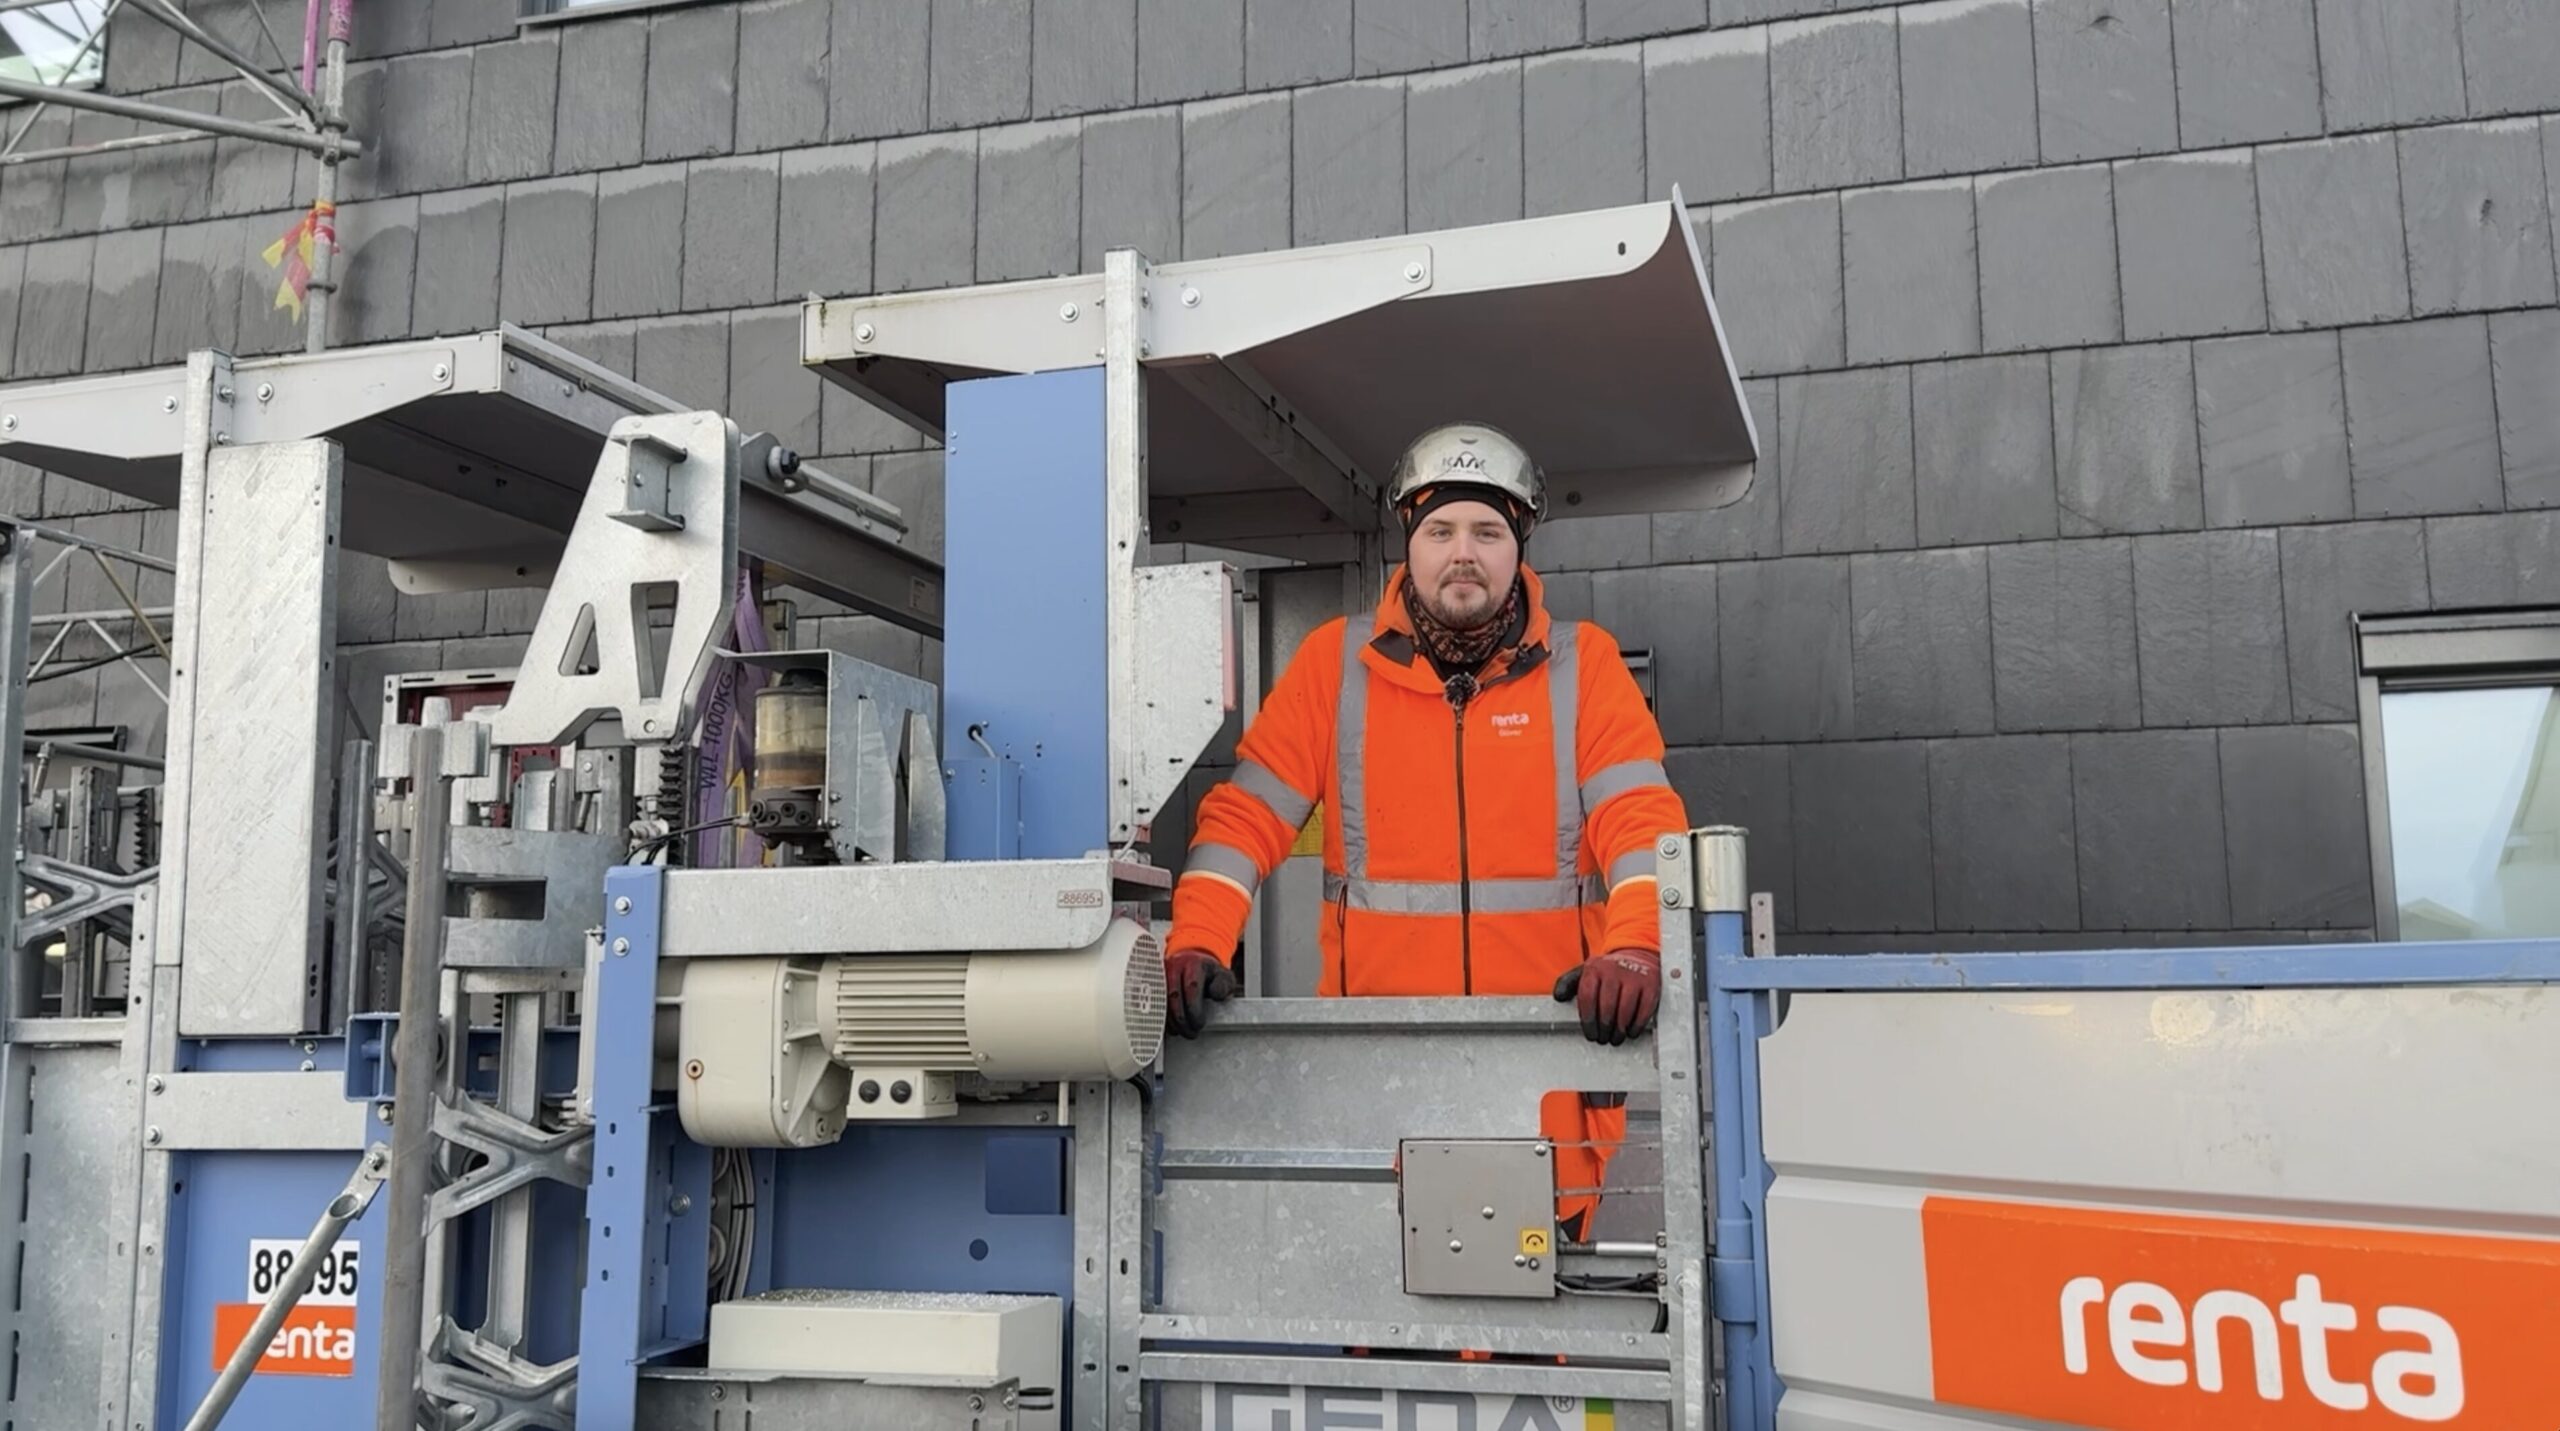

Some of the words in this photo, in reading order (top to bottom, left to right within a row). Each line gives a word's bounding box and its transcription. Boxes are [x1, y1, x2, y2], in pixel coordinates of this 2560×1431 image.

[702, 671, 734, 745] 1000KG
[1491, 713, 1530, 727] renta
[701, 752, 719, 789] WLL
[1063, 891, 1096, 905] 88695
[254, 1249, 358, 1296] 8895
[263, 1320, 356, 1361] enta
[2060, 1273, 2465, 1422] renta
